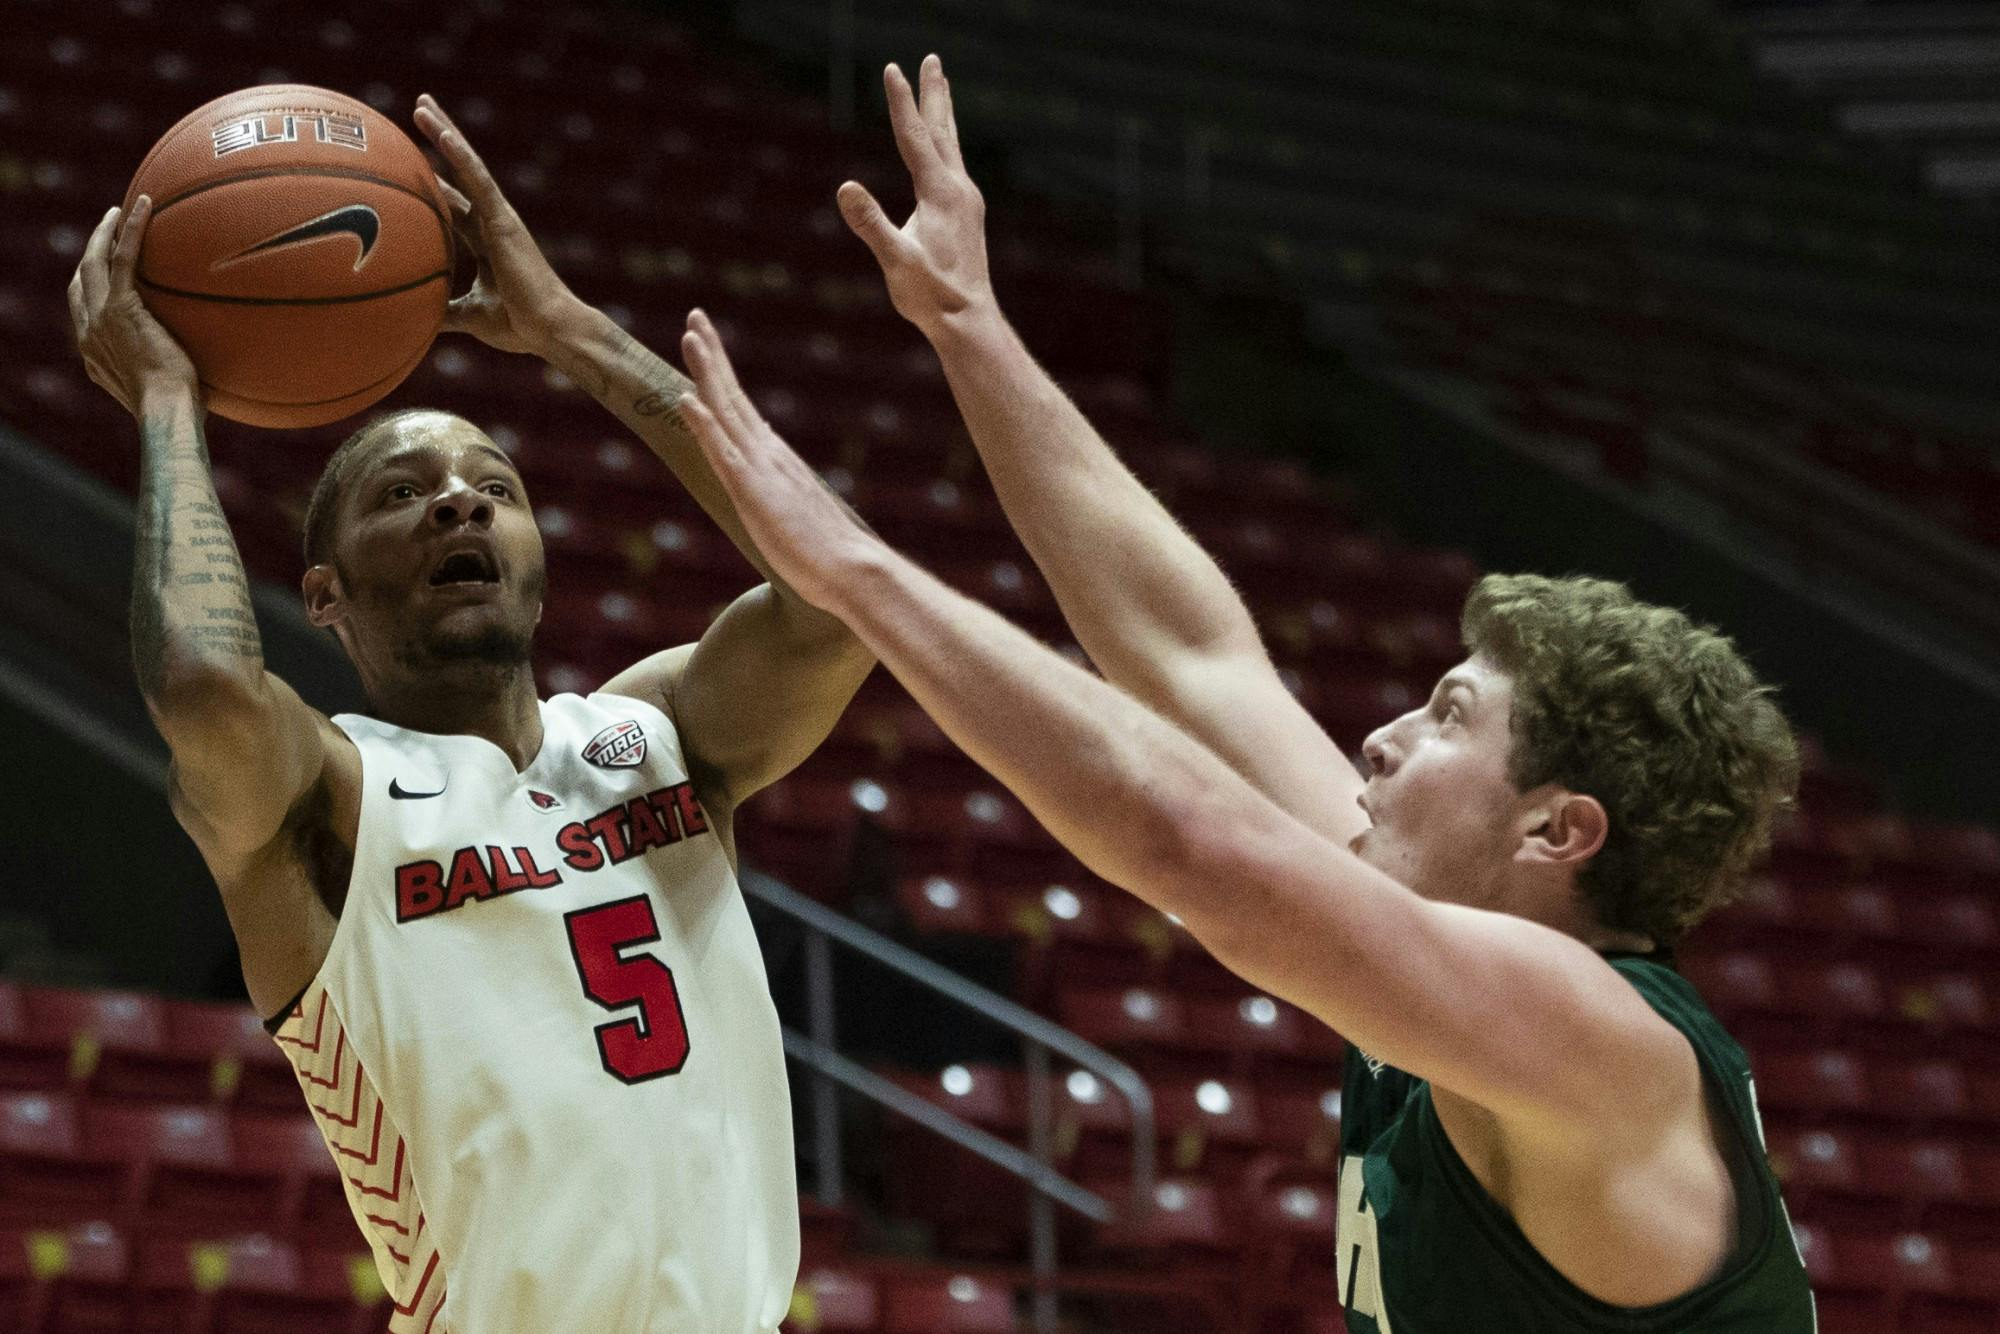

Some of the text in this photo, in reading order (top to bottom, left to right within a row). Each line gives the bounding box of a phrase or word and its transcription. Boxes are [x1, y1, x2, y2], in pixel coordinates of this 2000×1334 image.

[212, 114, 368, 159] ELITE
[593, 728, 645, 766] MAC
[394, 780, 709, 924] BALL STATE
[563, 892, 691, 1086] 5
